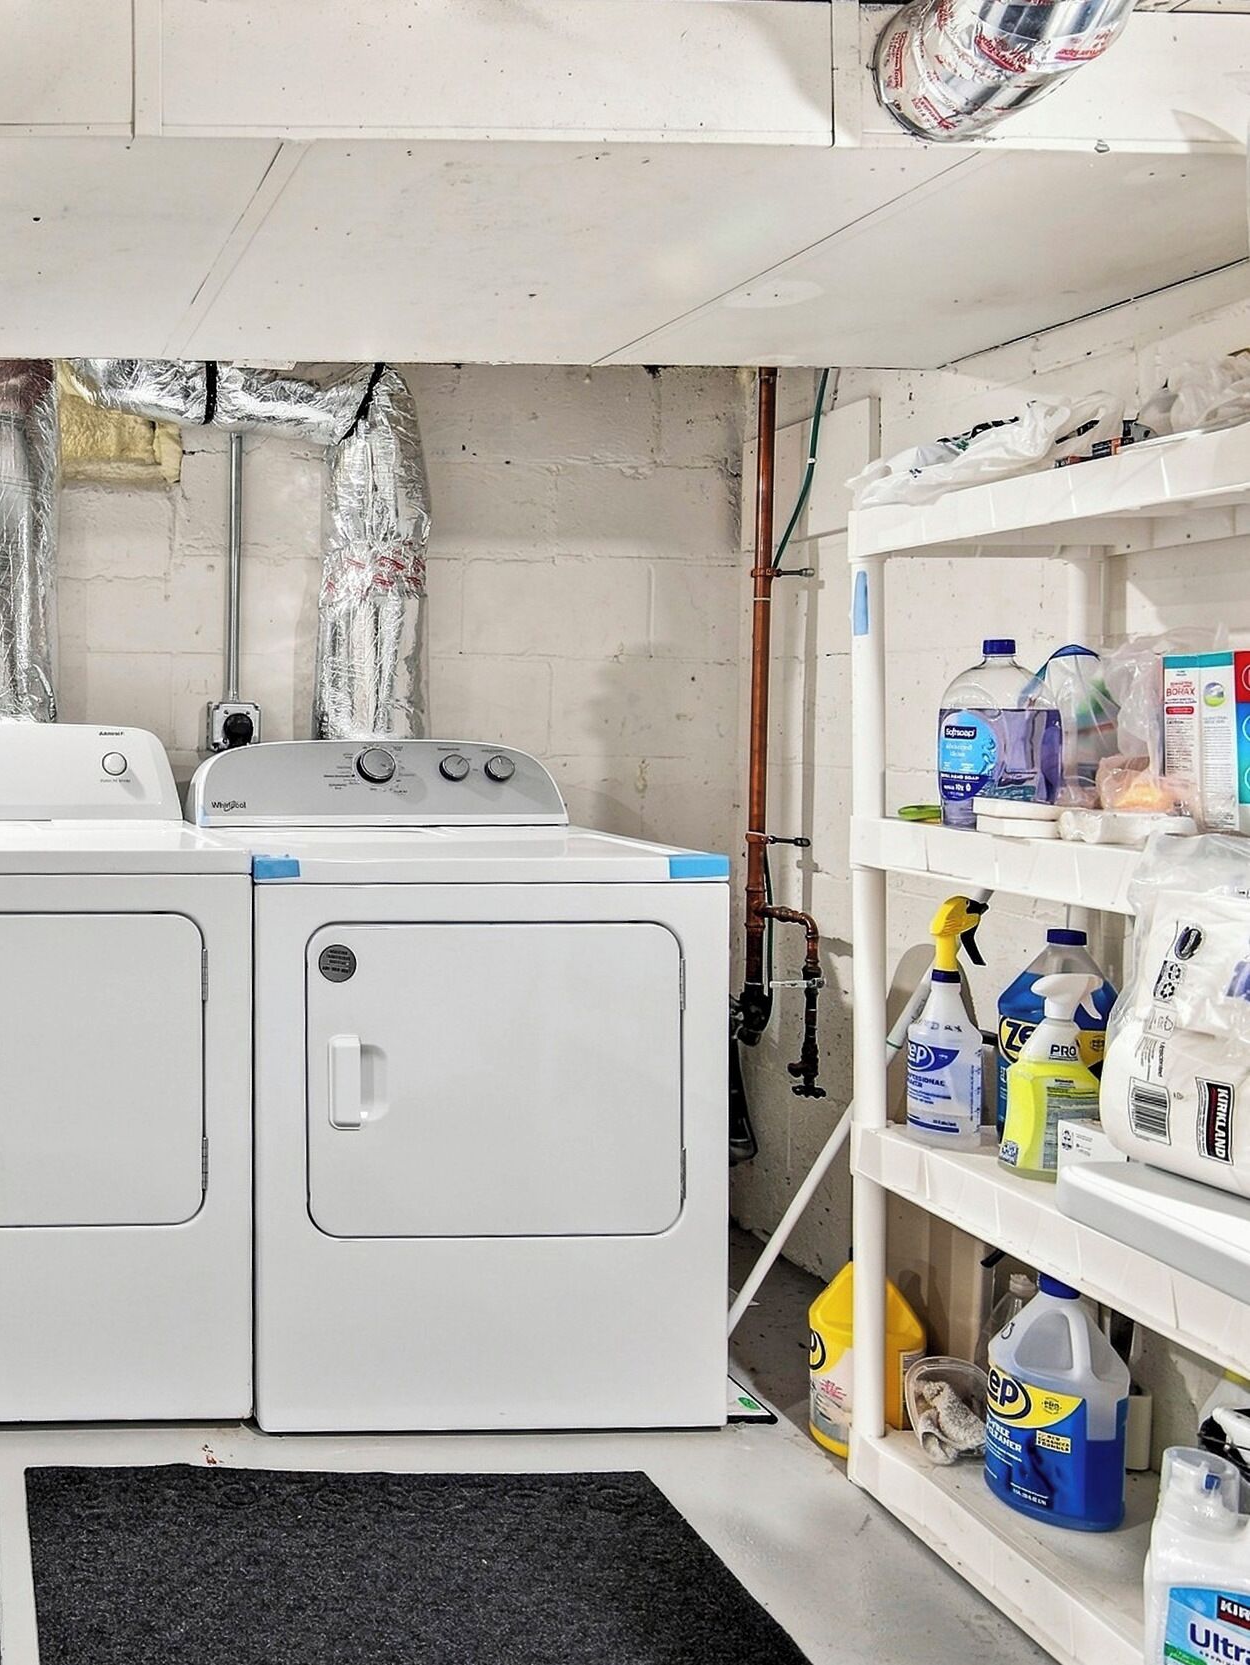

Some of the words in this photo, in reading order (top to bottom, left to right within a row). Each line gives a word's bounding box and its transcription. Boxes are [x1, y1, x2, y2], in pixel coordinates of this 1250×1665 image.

[1166, 687, 1196, 697] BORAX
[945, 727, 975, 738] Softsoap
[211, 800, 247, 812] Whirlpool
[1005, 1020, 1037, 1052] Ze
[909, 1042, 928, 1064] ep
[1050, 1044, 1077, 1057] PRO
[1214, 1088, 1229, 1158] KIRKLAND
[988, 1368, 1019, 1407] ep
